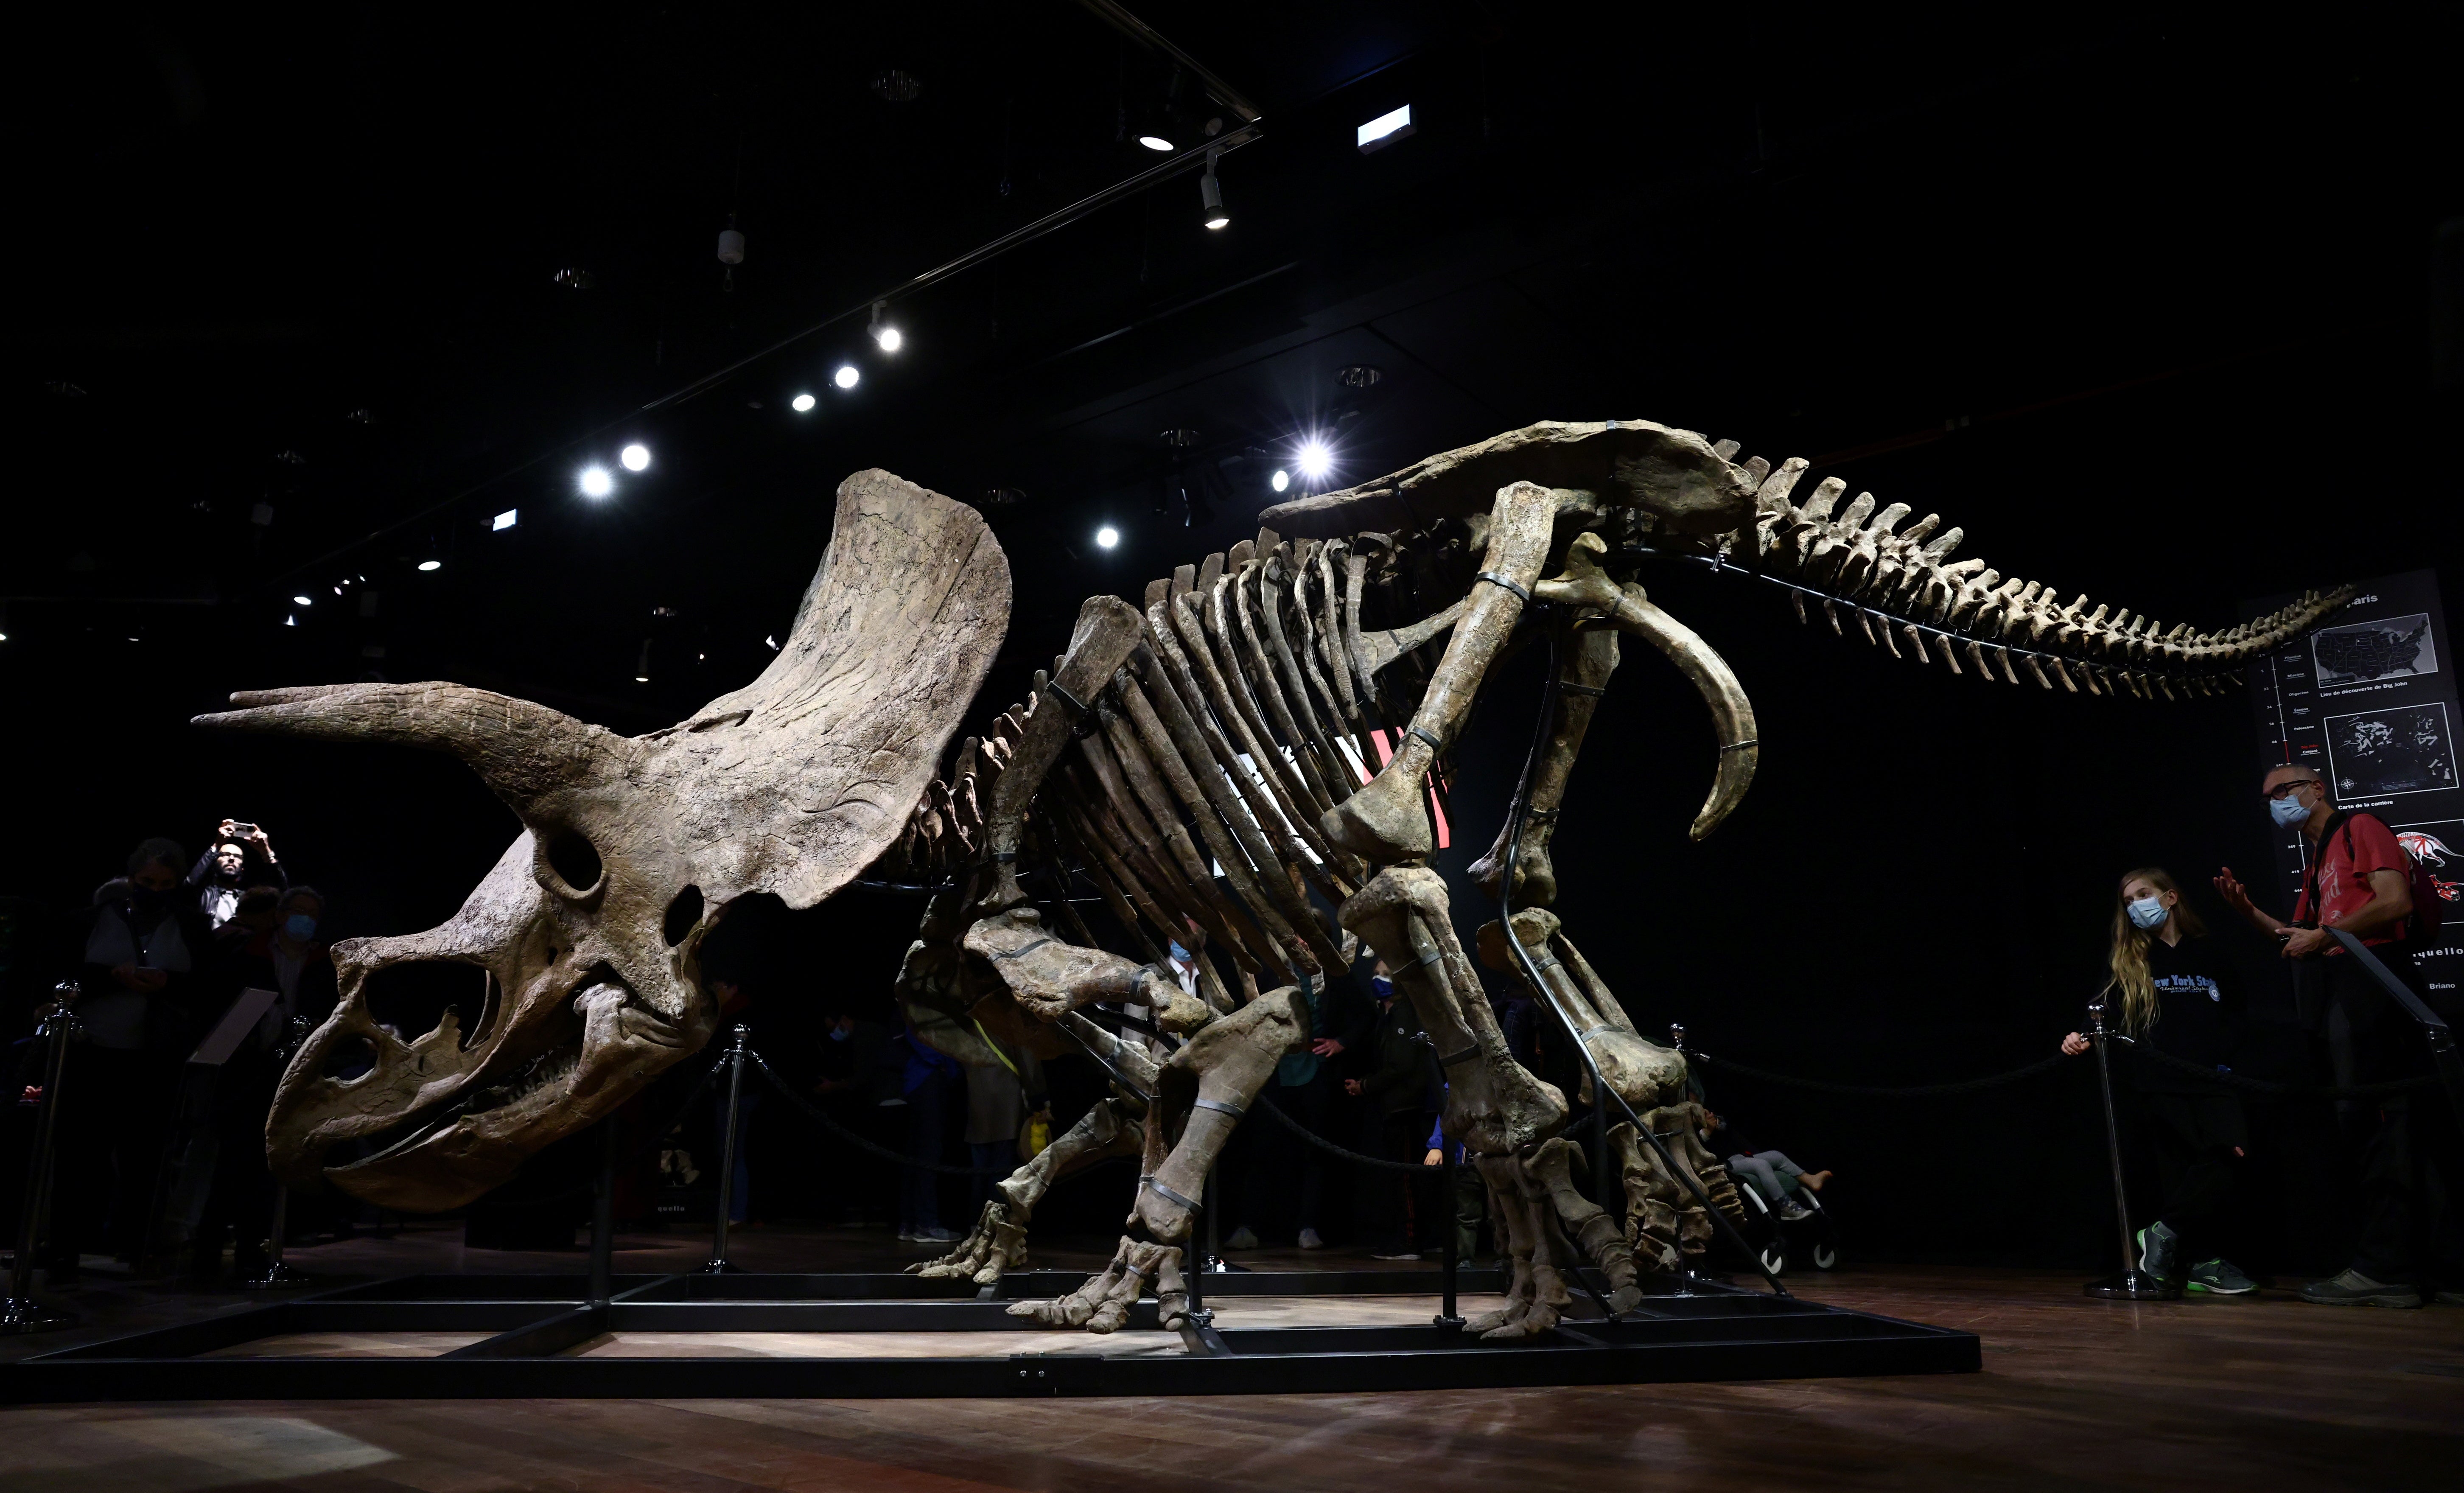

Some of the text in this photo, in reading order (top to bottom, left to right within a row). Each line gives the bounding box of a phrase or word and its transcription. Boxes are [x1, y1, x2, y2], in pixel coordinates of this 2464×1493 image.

[2352, 594, 2378, 605] aris
[2341, 686, 2373, 695] découverte
[2413, 947, 2464, 958] quello
[2153, 978, 2170, 988] ew
[2171, 974, 2195, 986] York
